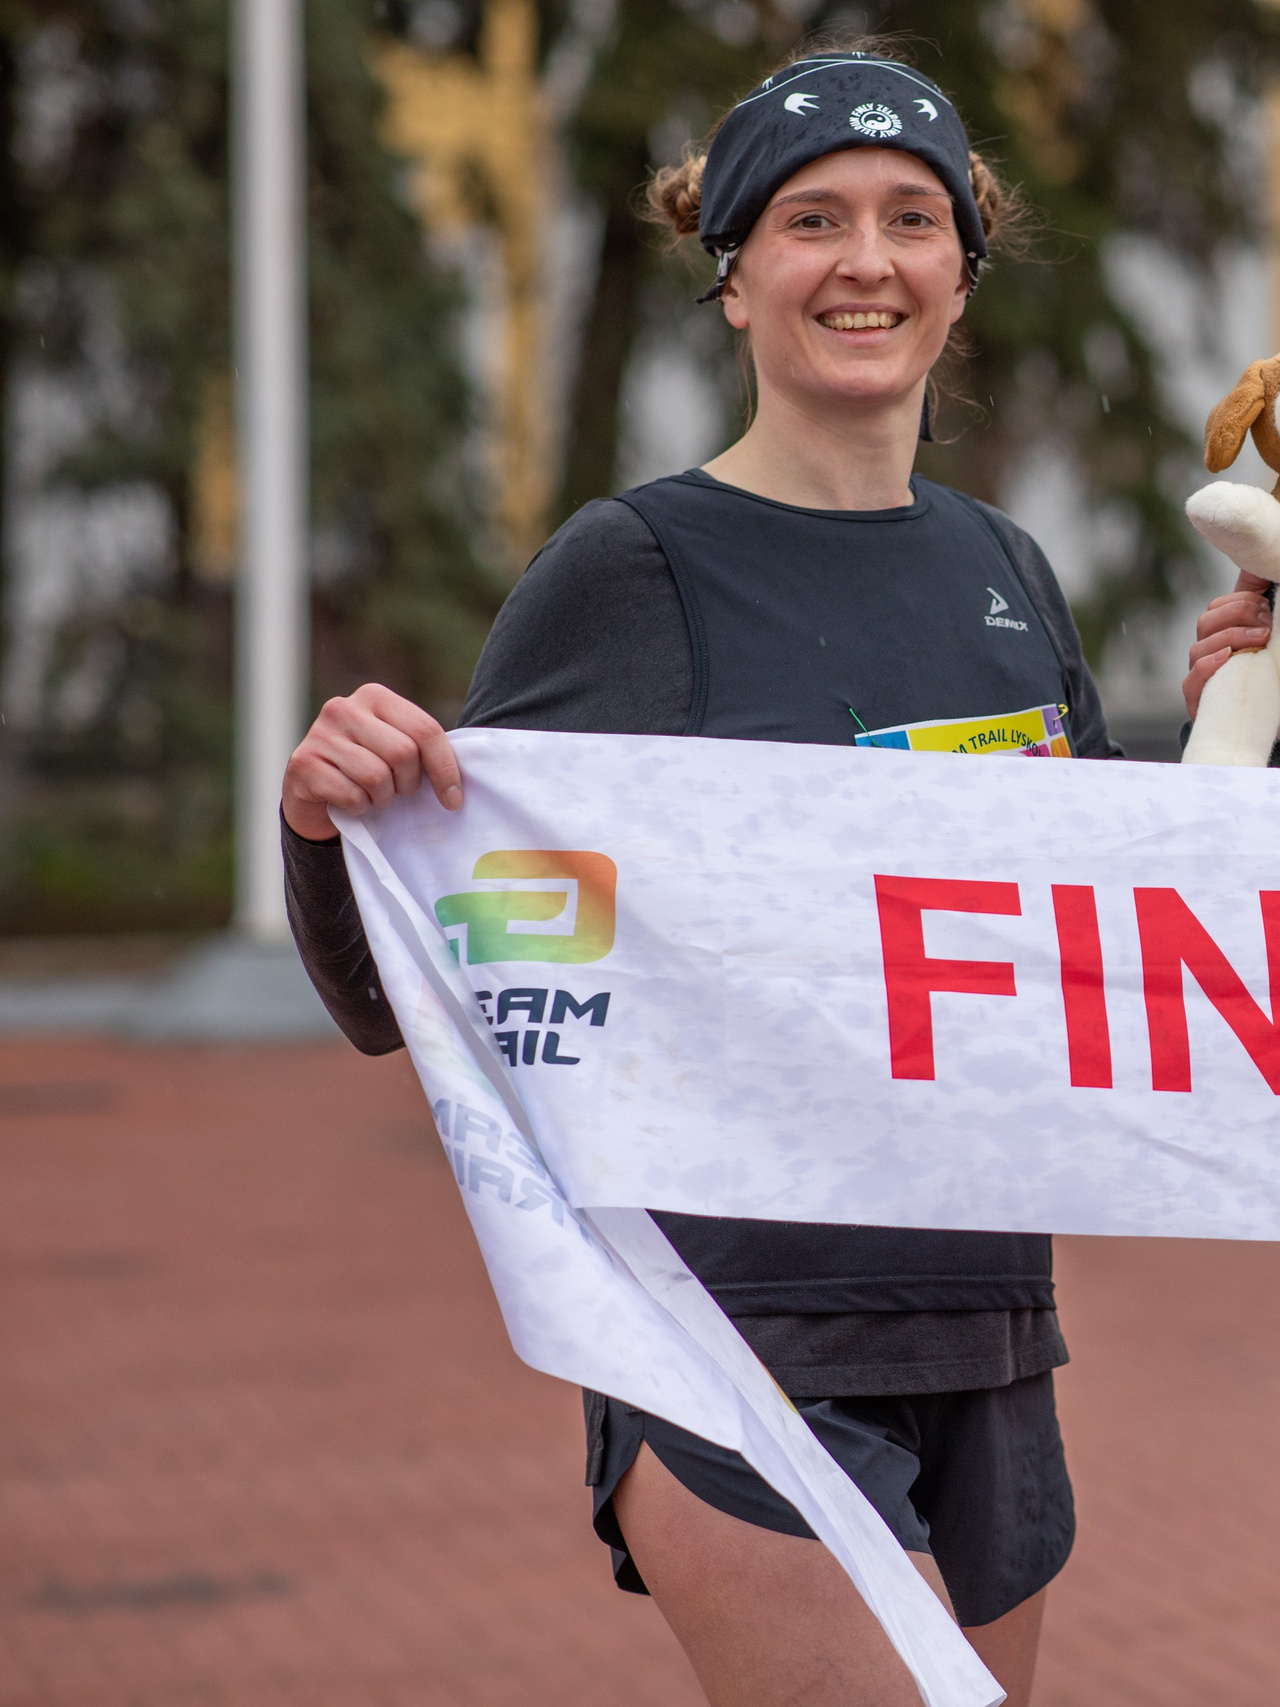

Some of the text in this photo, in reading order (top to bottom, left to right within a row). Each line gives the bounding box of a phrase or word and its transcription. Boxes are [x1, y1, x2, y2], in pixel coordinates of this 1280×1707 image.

[984, 615, 1029, 632] DEMIX
[968, 728, 1046, 757] TRAIL LYSKO
[494, 1030, 581, 1067] AIL
